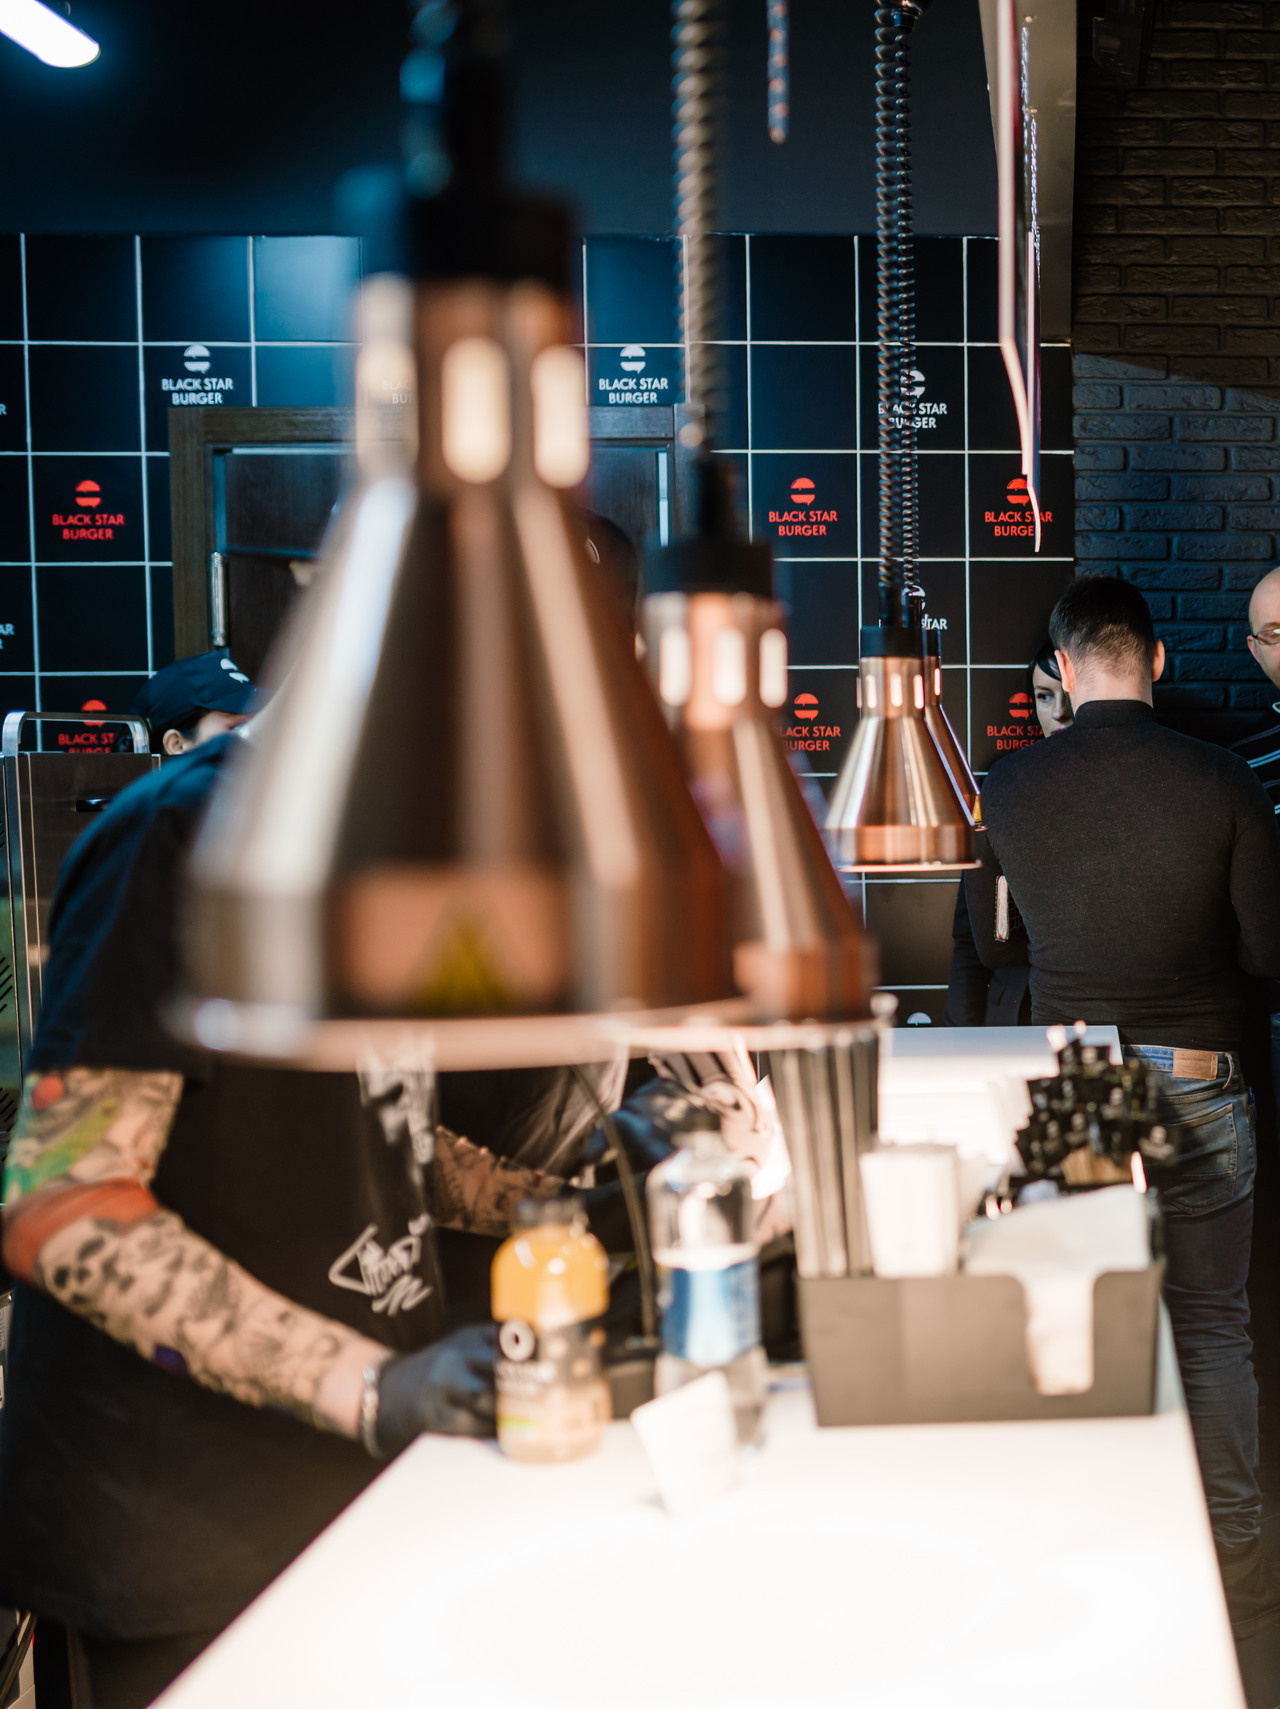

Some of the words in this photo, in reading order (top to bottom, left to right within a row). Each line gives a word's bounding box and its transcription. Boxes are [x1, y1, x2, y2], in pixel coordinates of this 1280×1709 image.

[161, 378, 201, 391] BLACK
[203, 378, 234, 390] STAR
[598, 378, 637, 390] BLACK
[639, 377, 669, 390] STAR
[171, 392, 223, 405] BURGER
[608, 392, 658, 404] BURGER
[918, 403, 948, 415] STAR
[52, 513, 92, 526] BLACK
[95, 513, 125, 525] STAR
[768, 510, 807, 523] BLACK
[809, 510, 838, 522] STAR
[984, 511, 1022, 523] BLACK
[62, 528, 114, 540] BURGER
[778, 525, 827, 537] BURGER
[994, 525, 1035, 537] BURGE
[812, 726, 841, 737] STAR
[986, 725, 1024, 737] BLACK
[58, 733, 98, 746] BLACK
